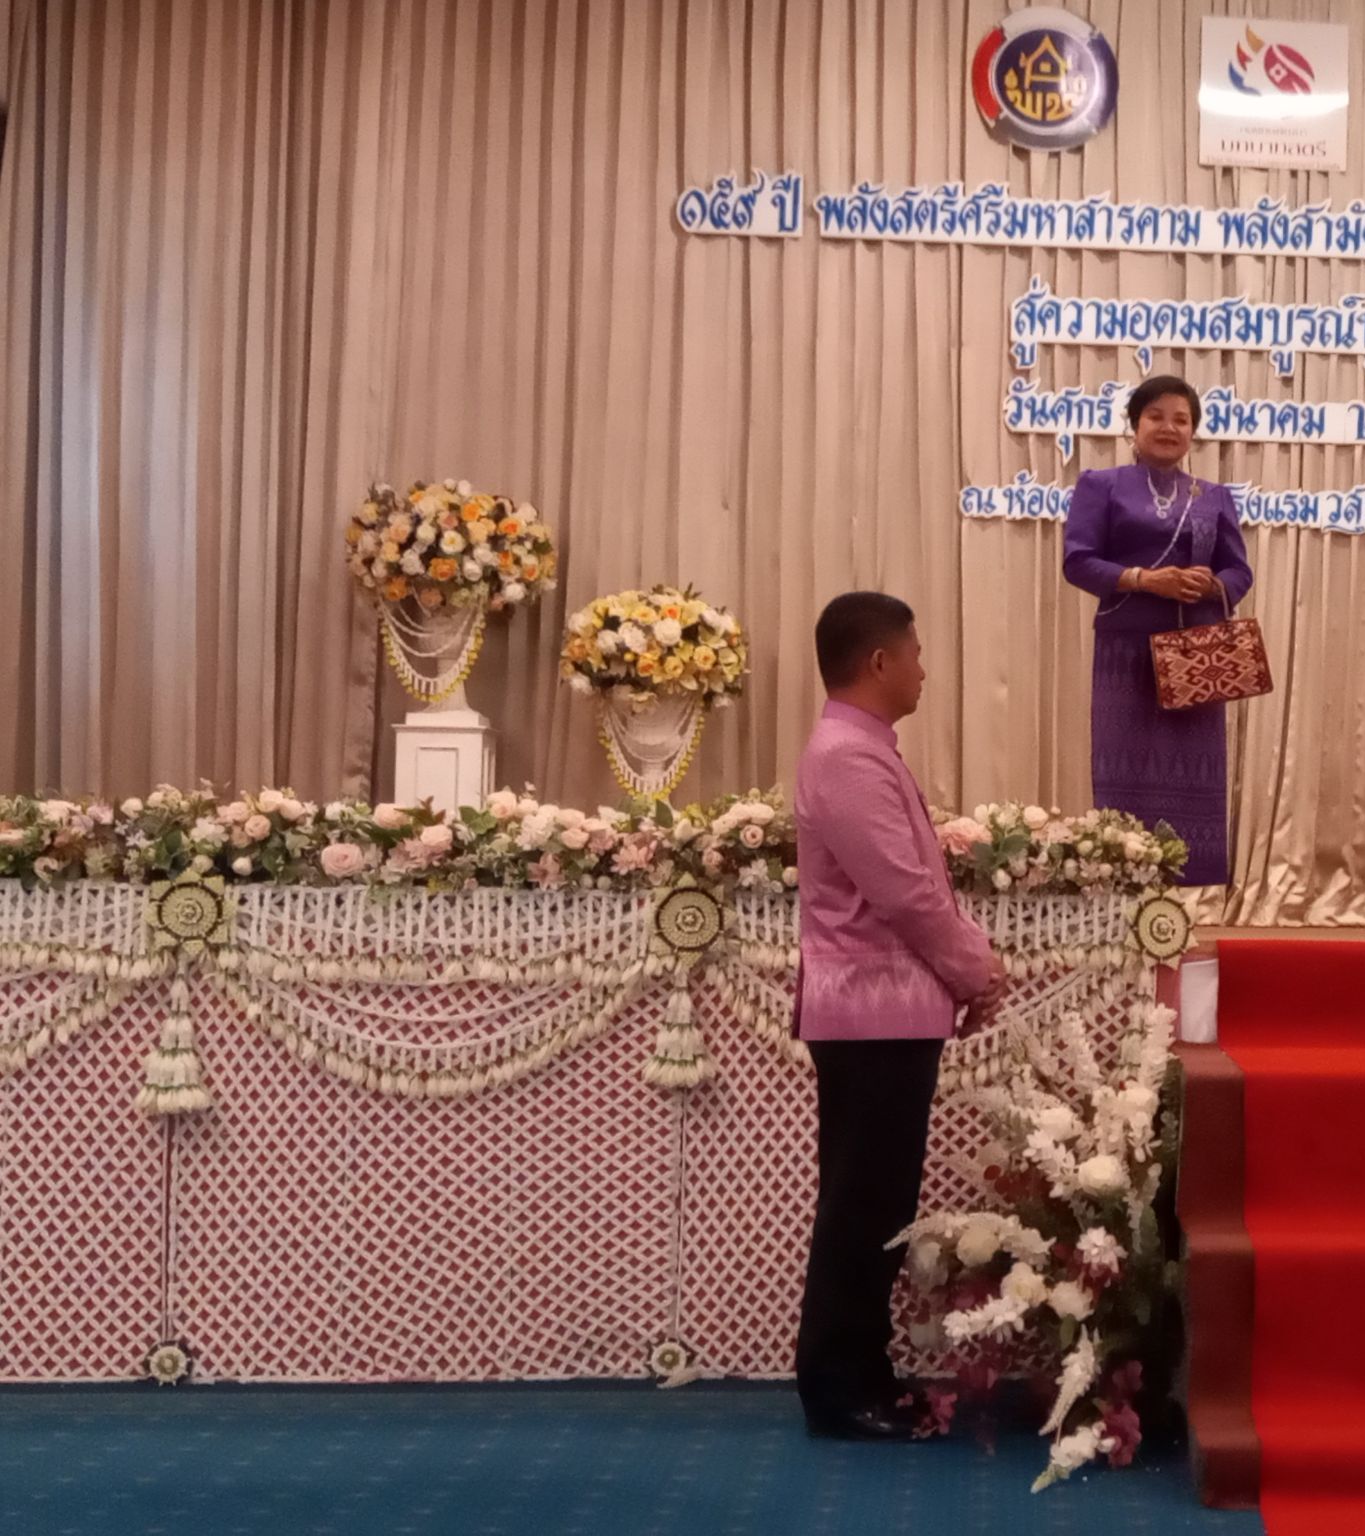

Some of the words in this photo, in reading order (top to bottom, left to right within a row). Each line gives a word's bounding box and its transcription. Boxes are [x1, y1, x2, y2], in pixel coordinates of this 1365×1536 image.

[680, 172, 765, 231] ๑๕๙
[771, 173, 800, 233] ปี
[816, 180, 1201, 246] พลังสตรีศรีมหาสารคาม
[1007, 379, 1125, 456] วันศุกร์
[1205, 389, 1326, 439] มีนาคม
[962, 486, 997, 514] ณ
[1224, 486, 1319, 523] รงแรม
